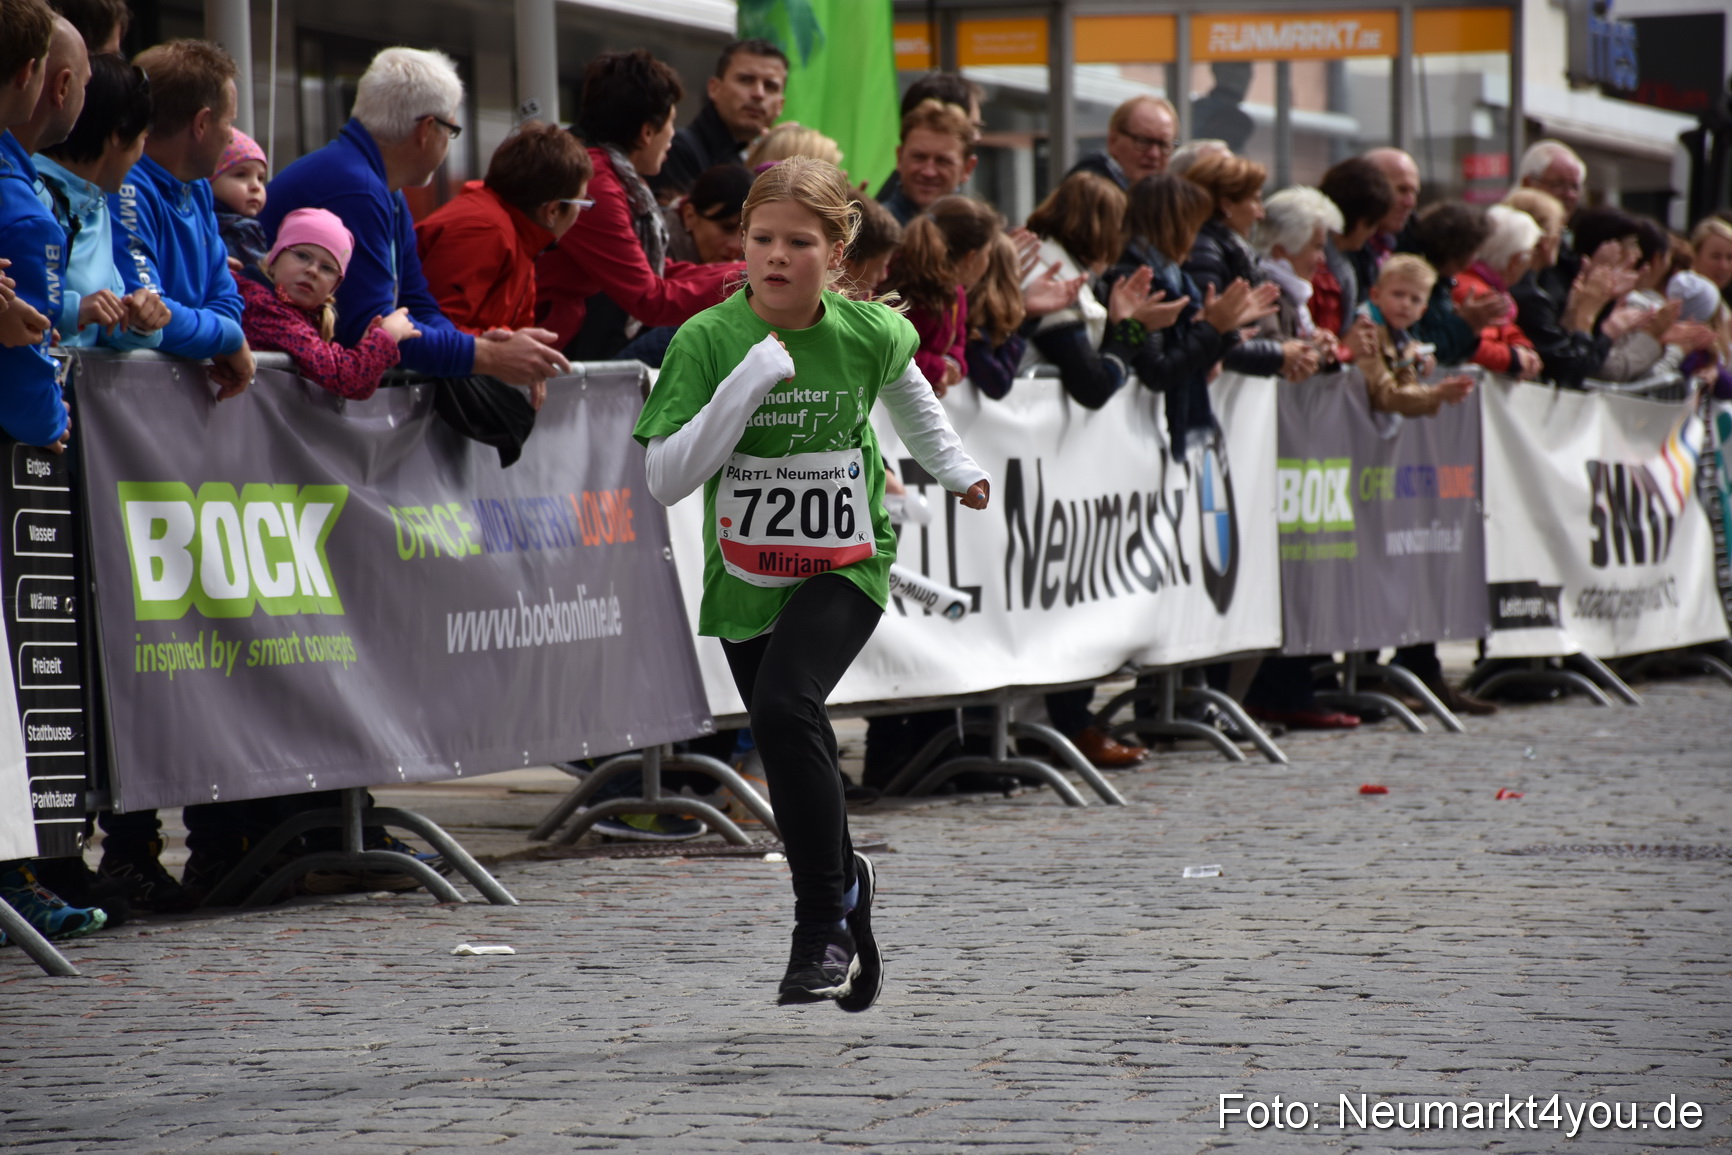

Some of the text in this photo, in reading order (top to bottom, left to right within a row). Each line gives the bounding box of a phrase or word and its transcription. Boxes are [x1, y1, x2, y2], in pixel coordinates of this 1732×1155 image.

[45, 243, 61, 305] BMW
[761, 387, 830, 406] markter
[26, 458, 51, 478] Erdgas
[726, 465, 773, 481] PARTL
[776, 466, 846, 480] Neumarkt
[1278, 467, 1354, 524] BOCK
[733, 486, 856, 540] 7206
[387, 502, 482, 561] OFFICE
[124, 500, 336, 602] BOCK
[758, 551, 832, 577] Mirjam
[30, 592, 58, 611] Wärme
[32, 656, 63, 675] Freizeit
[135, 630, 206, 681] inspired
[210, 630, 242, 678] by
[246, 630, 305, 667] smart
[27, 724, 72, 742] Stadtbusse
[31, 790, 77, 809] Parkhäuser
